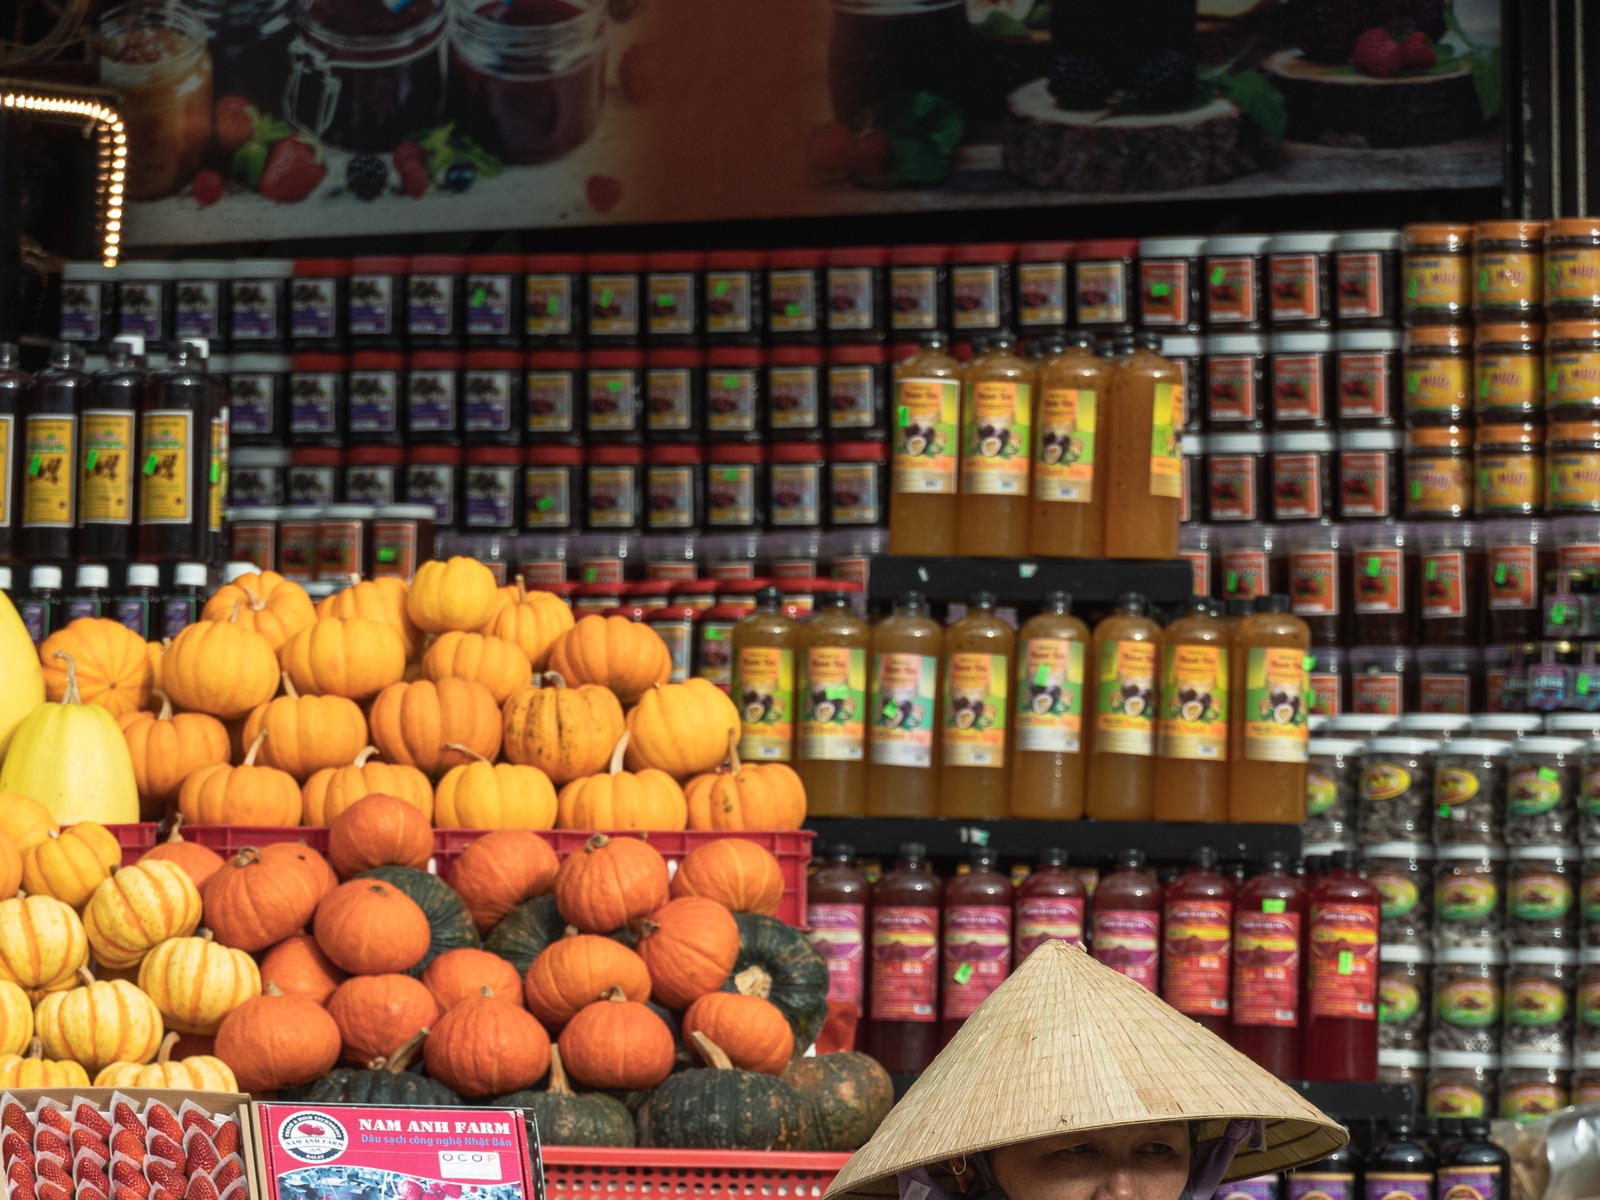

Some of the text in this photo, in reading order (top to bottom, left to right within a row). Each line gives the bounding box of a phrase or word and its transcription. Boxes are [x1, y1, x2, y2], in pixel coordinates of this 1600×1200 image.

[314, 1116, 342, 1138] TECHNOLOGY
[358, 1119, 511, 1135] NAM ANH FARM
[322, 1139, 344, 1147] FARM
[361, 1134, 513, 1147] Dâu sạch công nghệ Nhật Bản
[442, 1153, 496, 1163] OCOP
